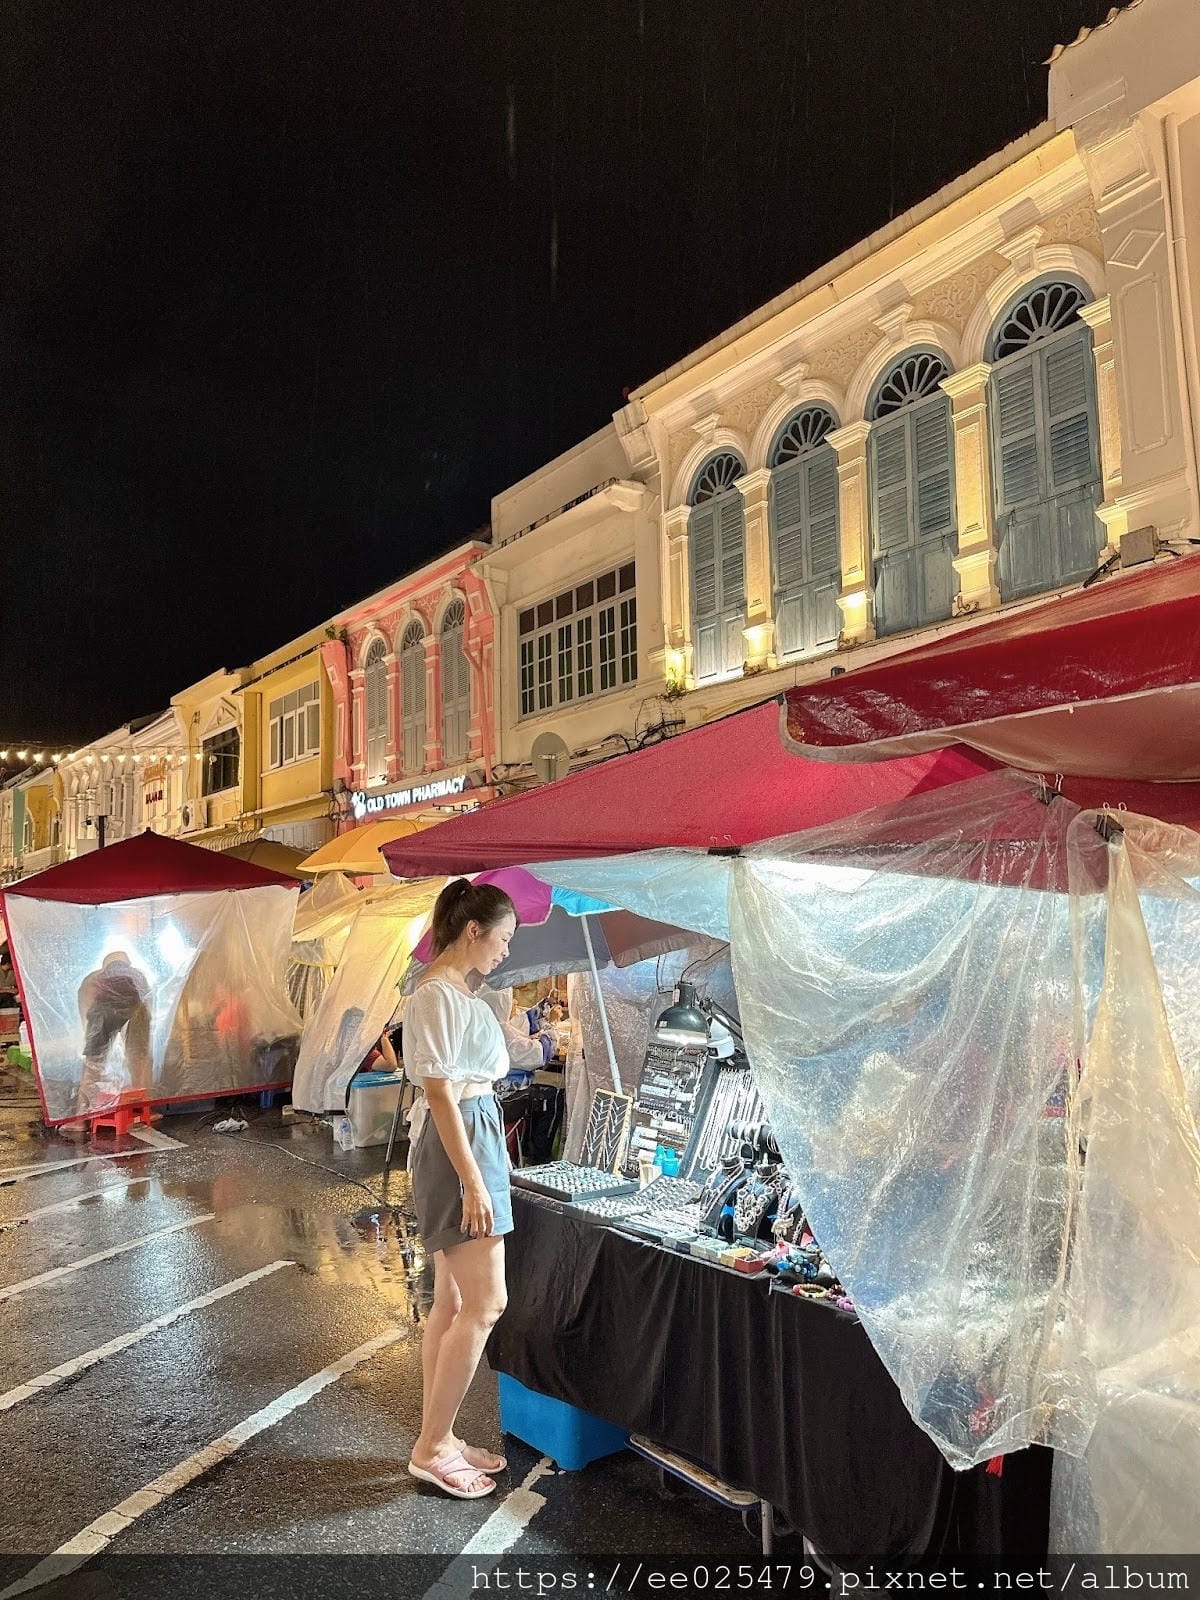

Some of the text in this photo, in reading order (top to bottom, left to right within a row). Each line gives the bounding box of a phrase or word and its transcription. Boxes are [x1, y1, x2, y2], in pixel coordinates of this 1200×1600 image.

[366, 775, 466, 813] OLD TOWN PHARMACY
